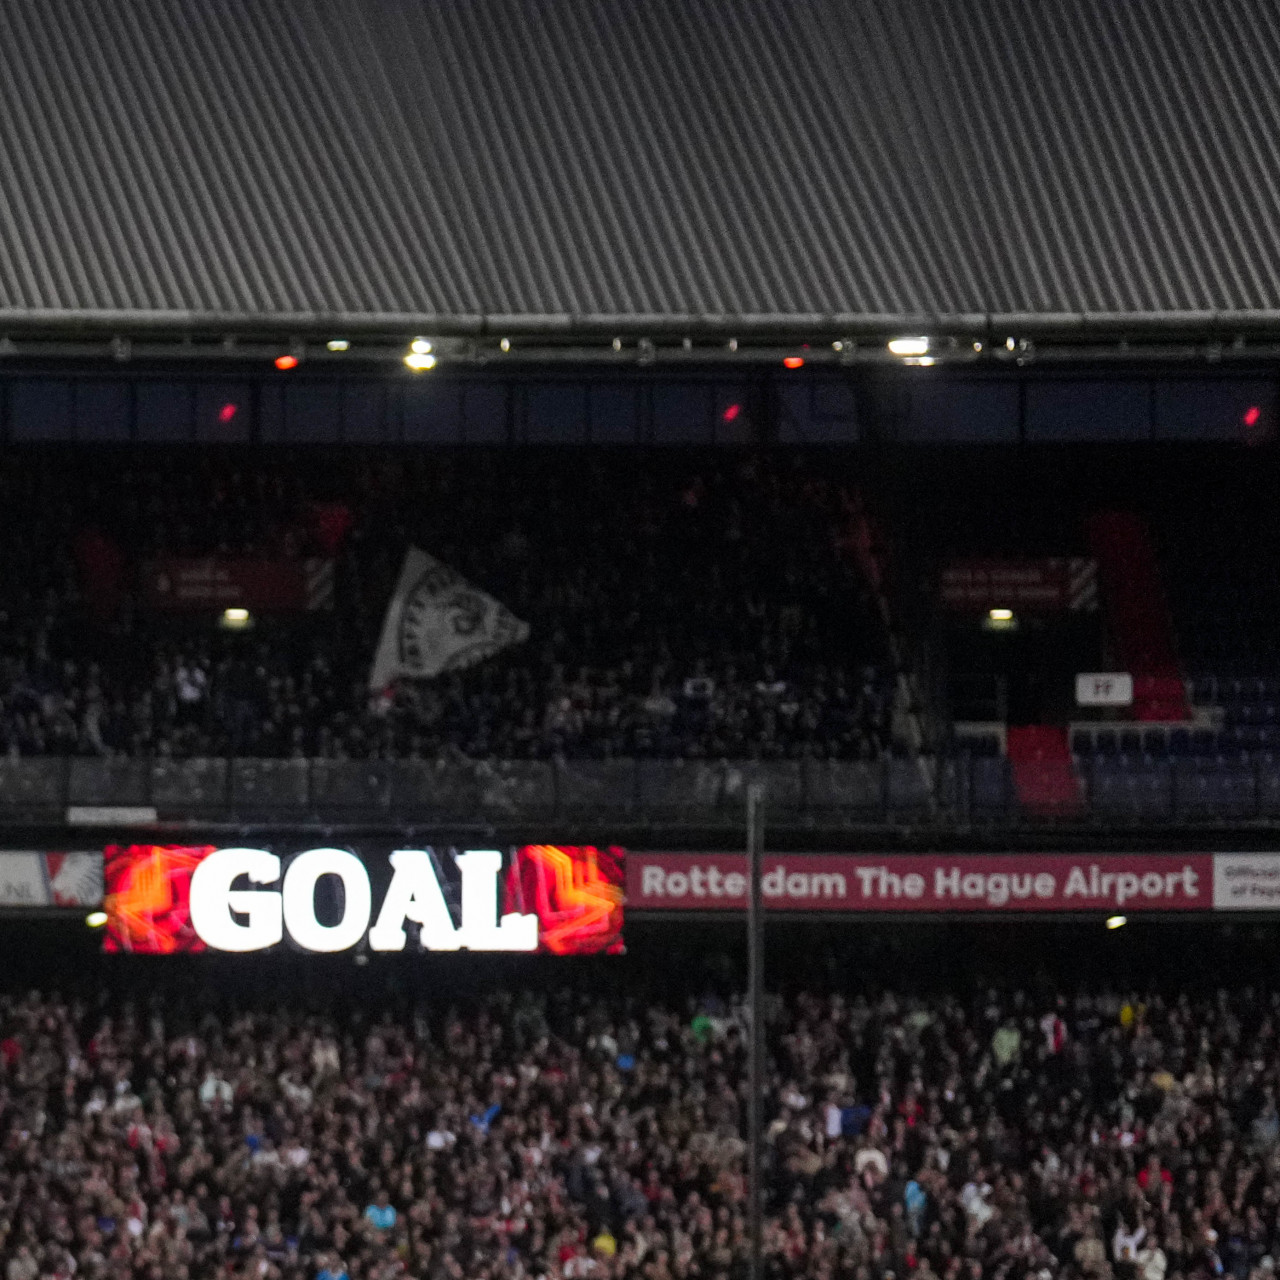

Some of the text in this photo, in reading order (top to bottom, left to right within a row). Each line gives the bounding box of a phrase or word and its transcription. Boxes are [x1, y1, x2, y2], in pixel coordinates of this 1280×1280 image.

[189, 847, 538, 952] GOAL
[642, 865, 847, 897] Rottedam
[854, 866, 925, 898] The
[935, 866, 1057, 907] Hague
[1064, 866, 1198, 906] Airport
